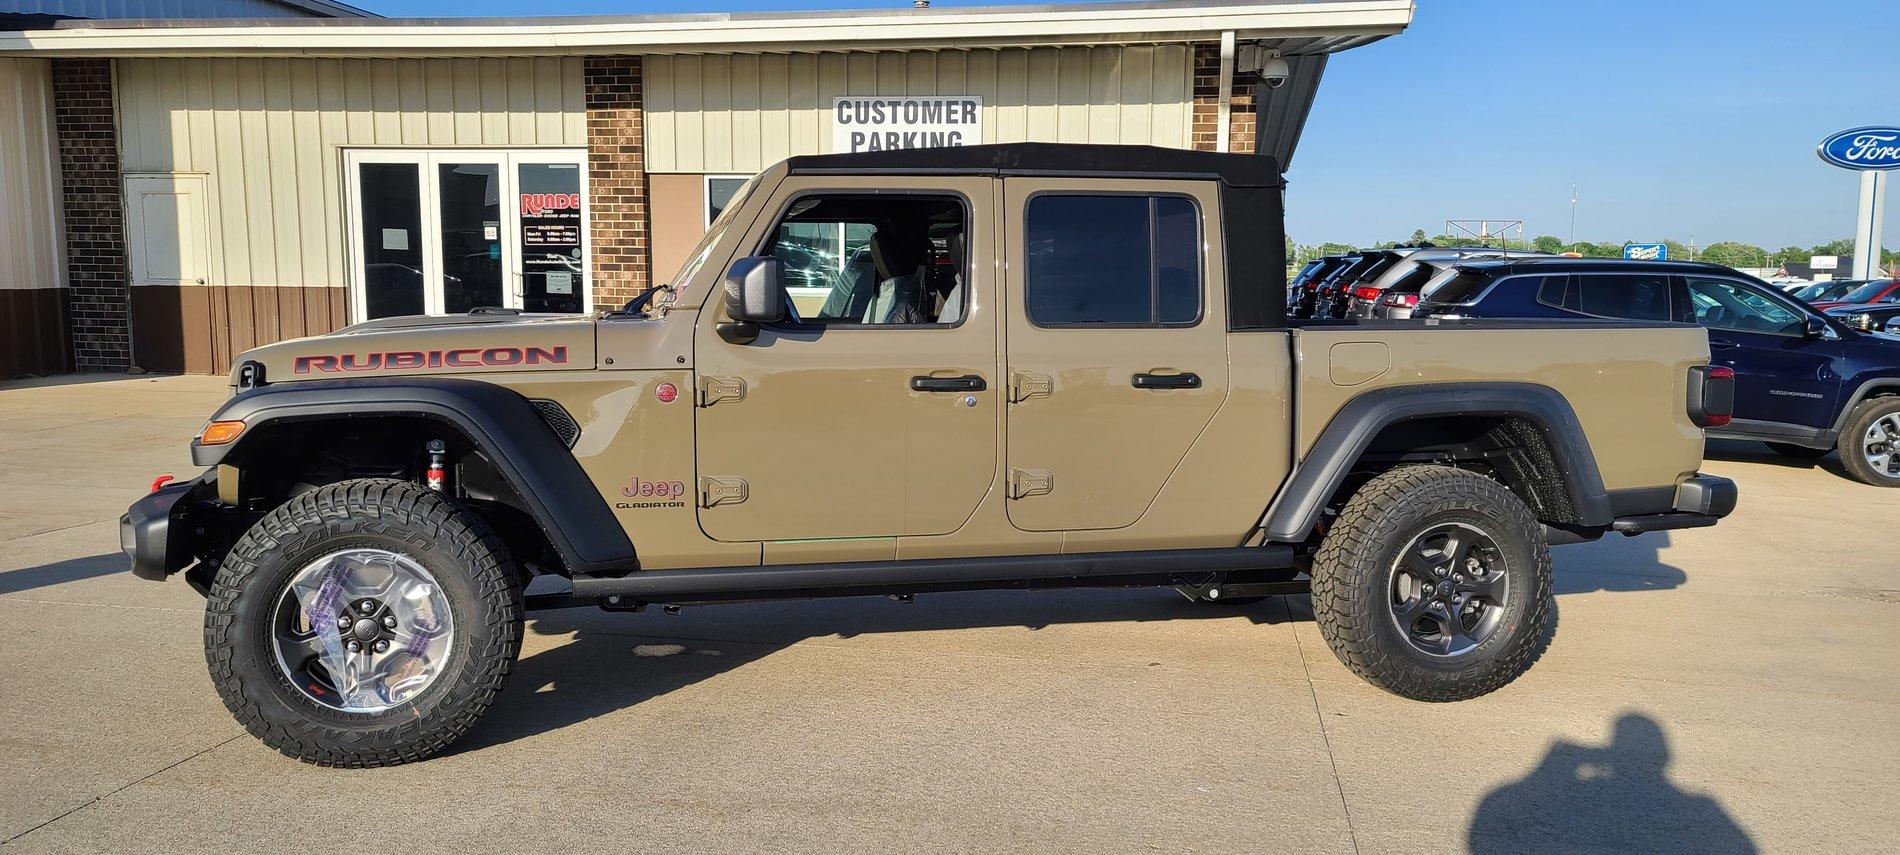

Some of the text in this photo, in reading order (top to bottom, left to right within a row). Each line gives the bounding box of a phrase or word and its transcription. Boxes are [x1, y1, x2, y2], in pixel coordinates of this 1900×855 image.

[837, 100, 977, 125] CUSTOMER
[851, 131, 962, 153] PARKING
[521, 194, 580, 215] RUNDE
[294, 346, 568, 375] RUBICON
[620, 476, 685, 500] Jeep
[616, 501, 685, 509] GLADIATOR
[281, 522, 436, 560] FALKEN
